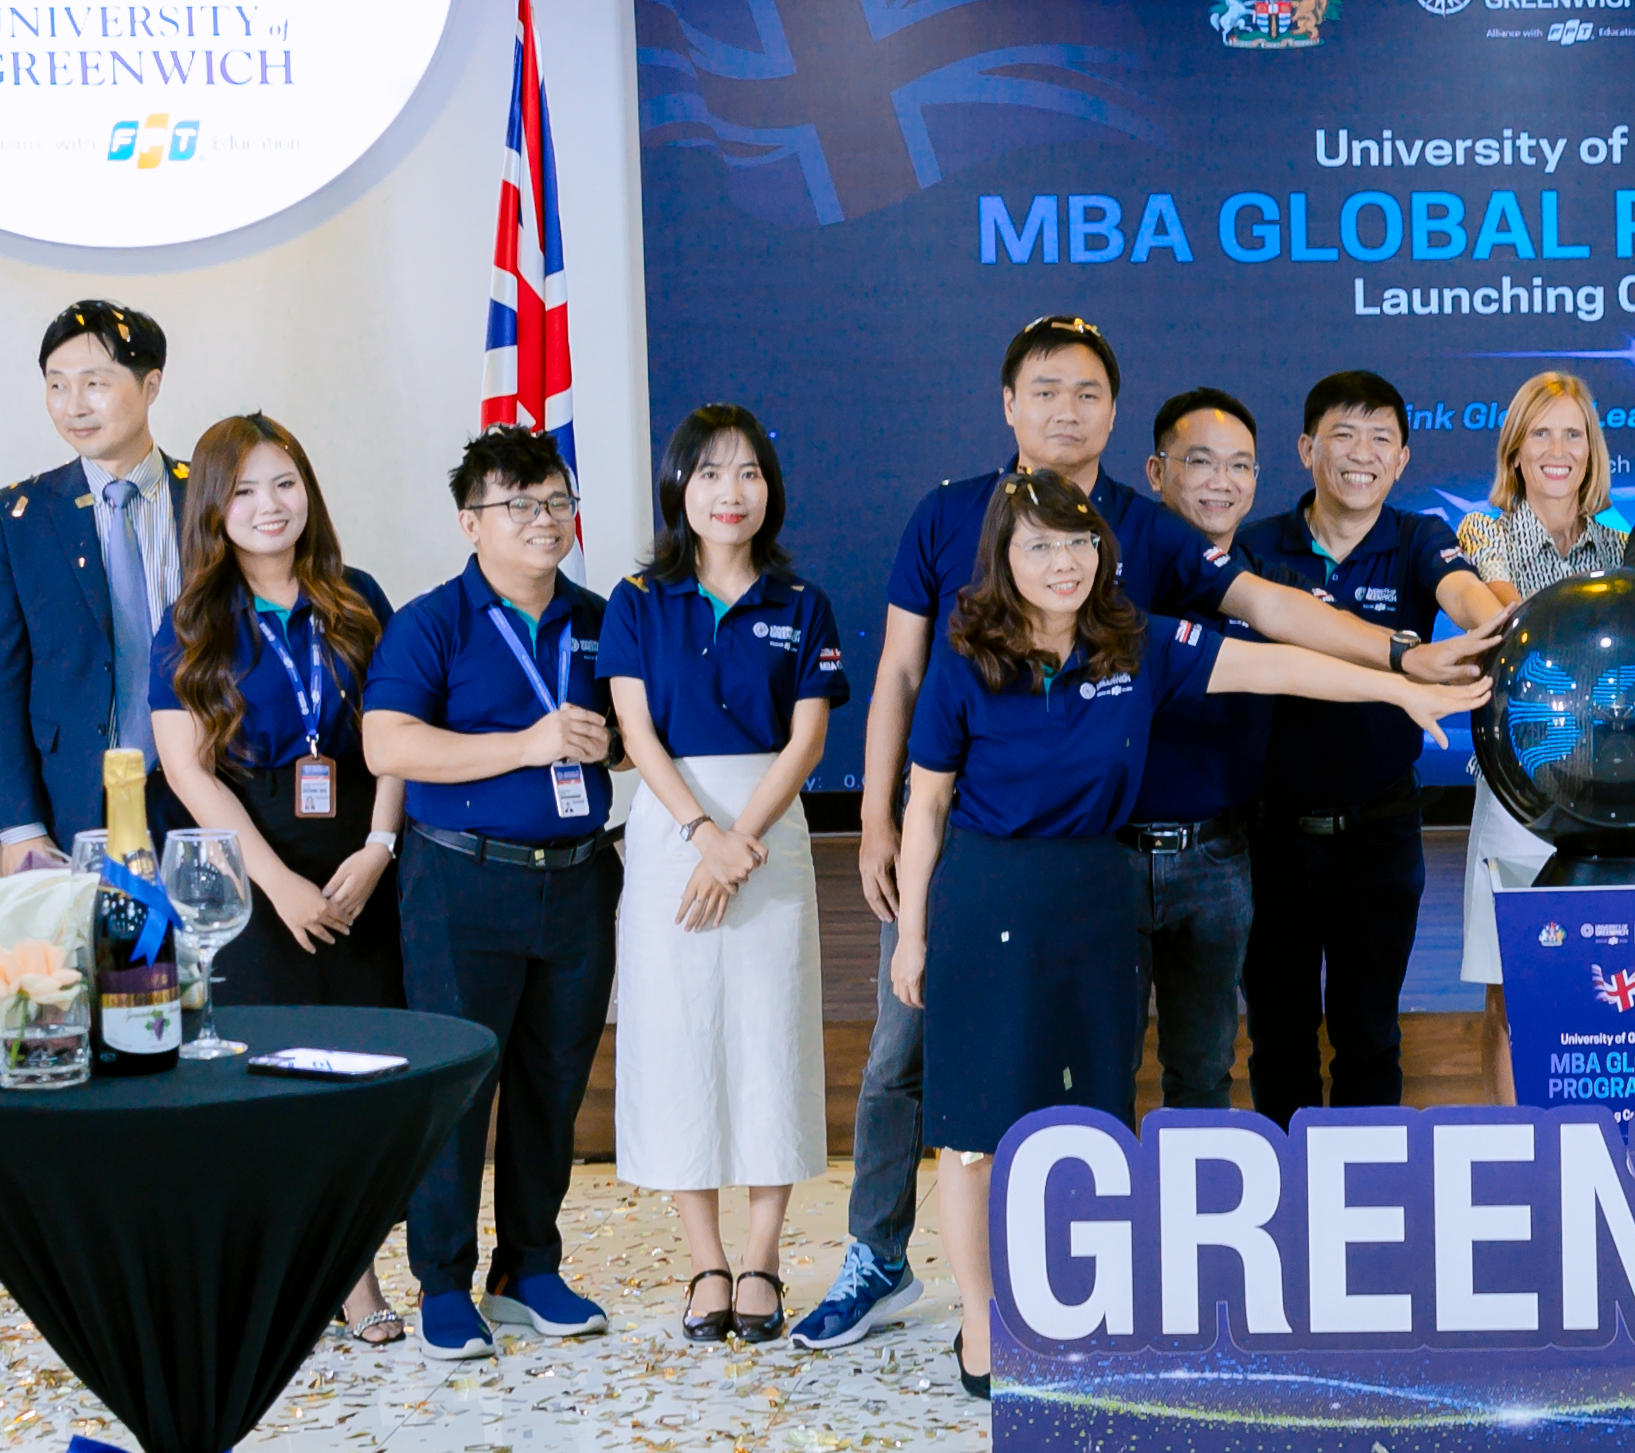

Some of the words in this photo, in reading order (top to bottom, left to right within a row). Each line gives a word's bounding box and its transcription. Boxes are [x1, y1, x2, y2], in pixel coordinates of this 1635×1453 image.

[269, 15, 292, 41] of
[1486, 28, 1521, 39] Alliance
[1523, 28, 1543, 39] with
[1315, 127, 1567, 174] University
[1579, 125, 1630, 166] of
[978, 192, 1193, 266] MBA
[1219, 188, 1592, 265] GLOBAL
[1354, 276, 1605, 323] Launching
[1560, 1032, 1614, 1047] University
[1614, 1031, 1627, 1045] of
[1550, 1051, 1602, 1075] MBA
